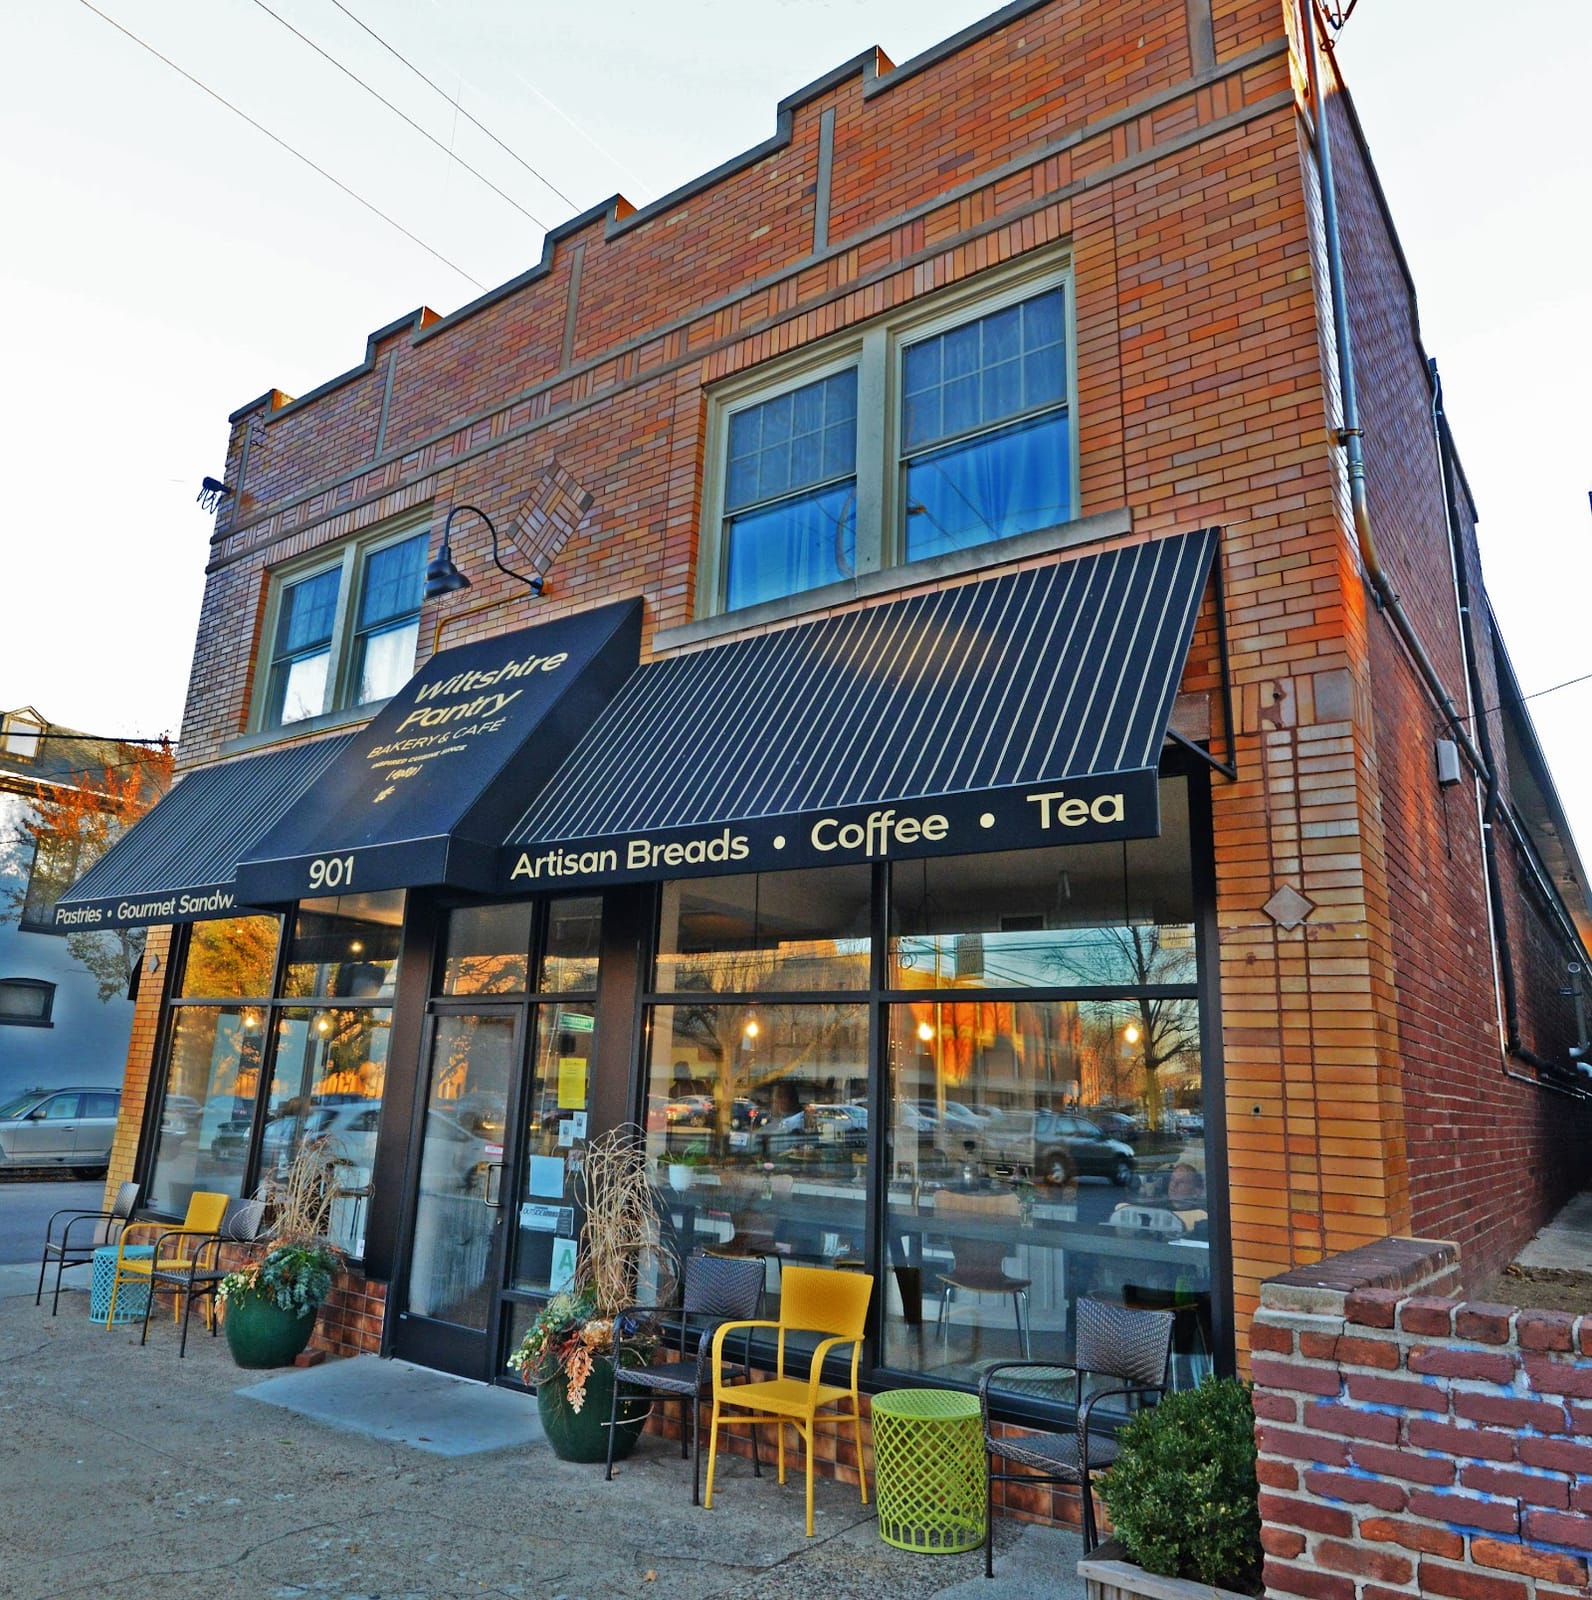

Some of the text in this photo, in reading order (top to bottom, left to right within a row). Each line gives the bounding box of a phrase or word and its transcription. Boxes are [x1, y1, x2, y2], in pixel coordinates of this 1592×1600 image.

[414, 652, 569, 704] Wiltshire
[395, 689, 524, 734] Pantry
[366, 735, 440, 759] BAKERY
[438, 731, 451, 744] &
[1026, 791, 1126, 829] Tea
[811, 809, 950, 857] Coffee
[510, 828, 750, 880] Artisan Breads
[308, 855, 355, 890] 901
[55, 903, 102, 926] Pastries
[117, 889, 238, 920] Gourmet Sandw
[558, 1248, 574, 1272] A
